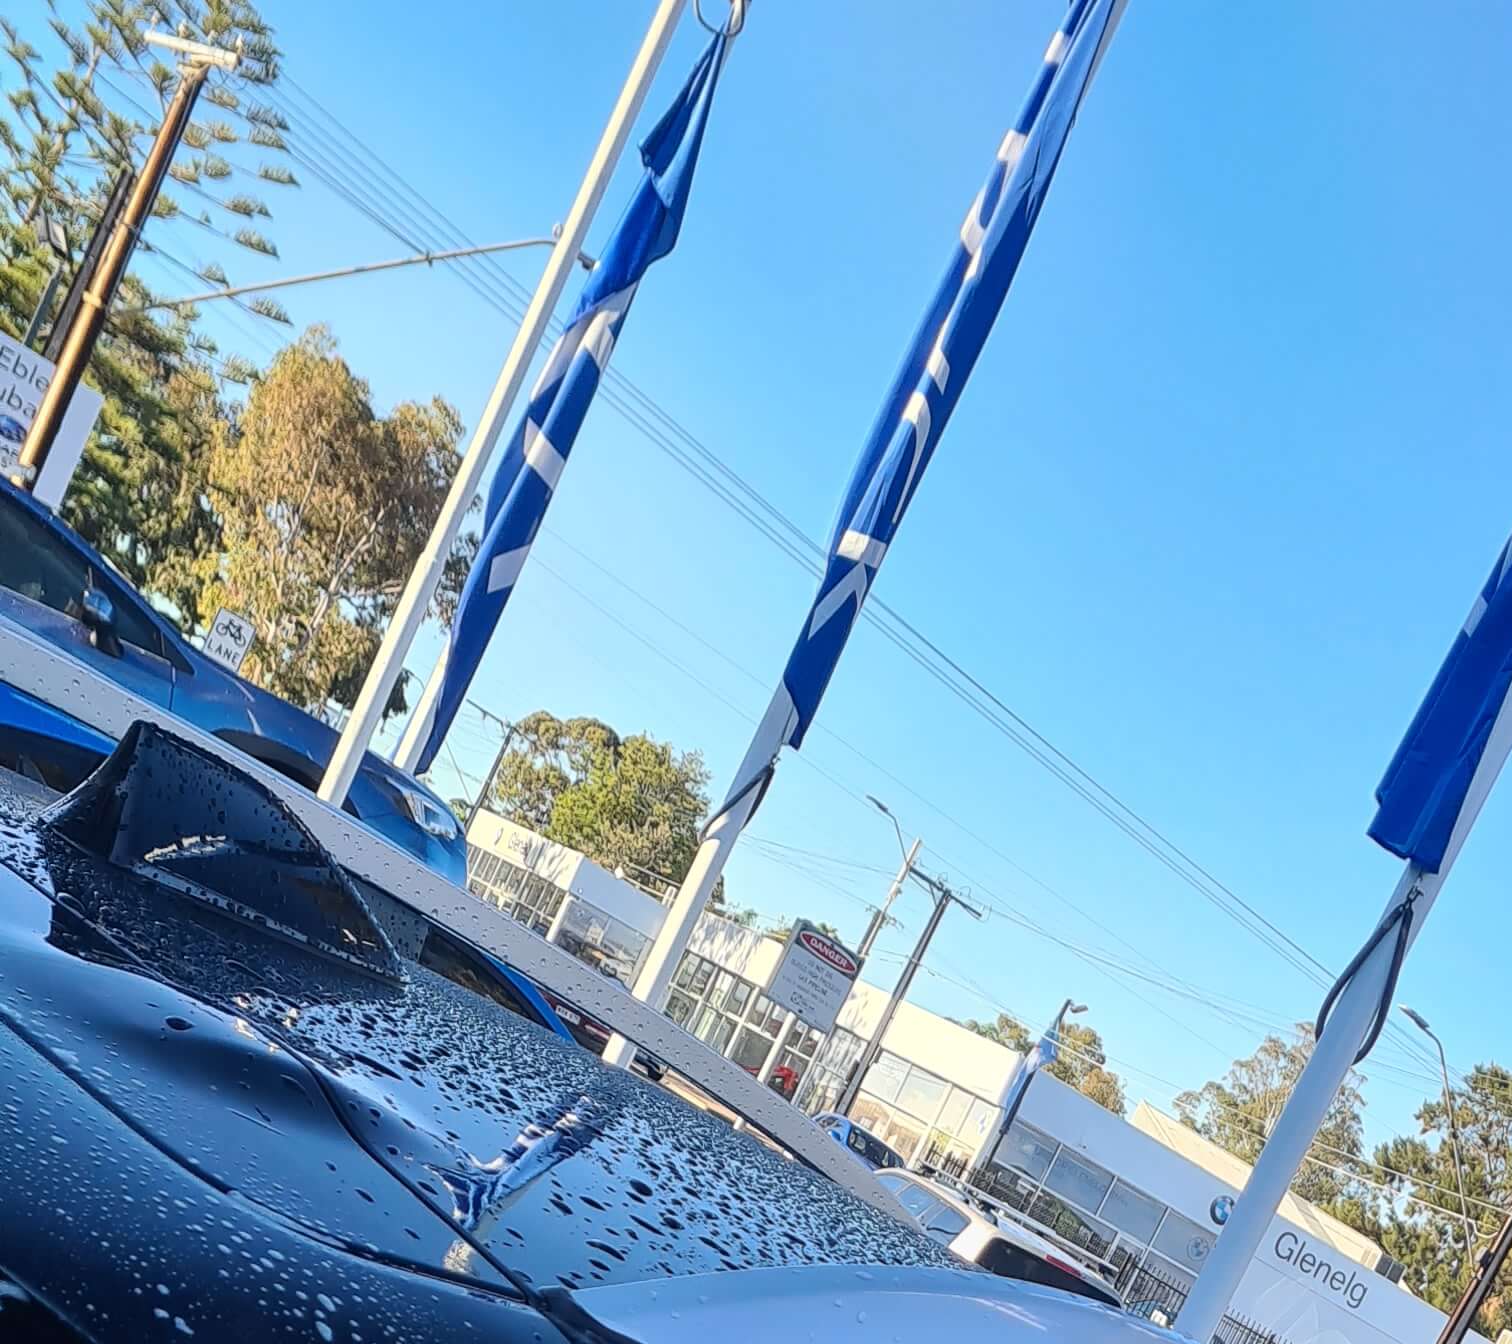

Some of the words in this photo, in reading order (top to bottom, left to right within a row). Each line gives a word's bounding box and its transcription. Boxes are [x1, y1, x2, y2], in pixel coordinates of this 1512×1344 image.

[208, 638, 241, 667] LANE
[810, 937, 849, 968] DANGER
[1274, 1231, 1368, 1309] Glenelg
